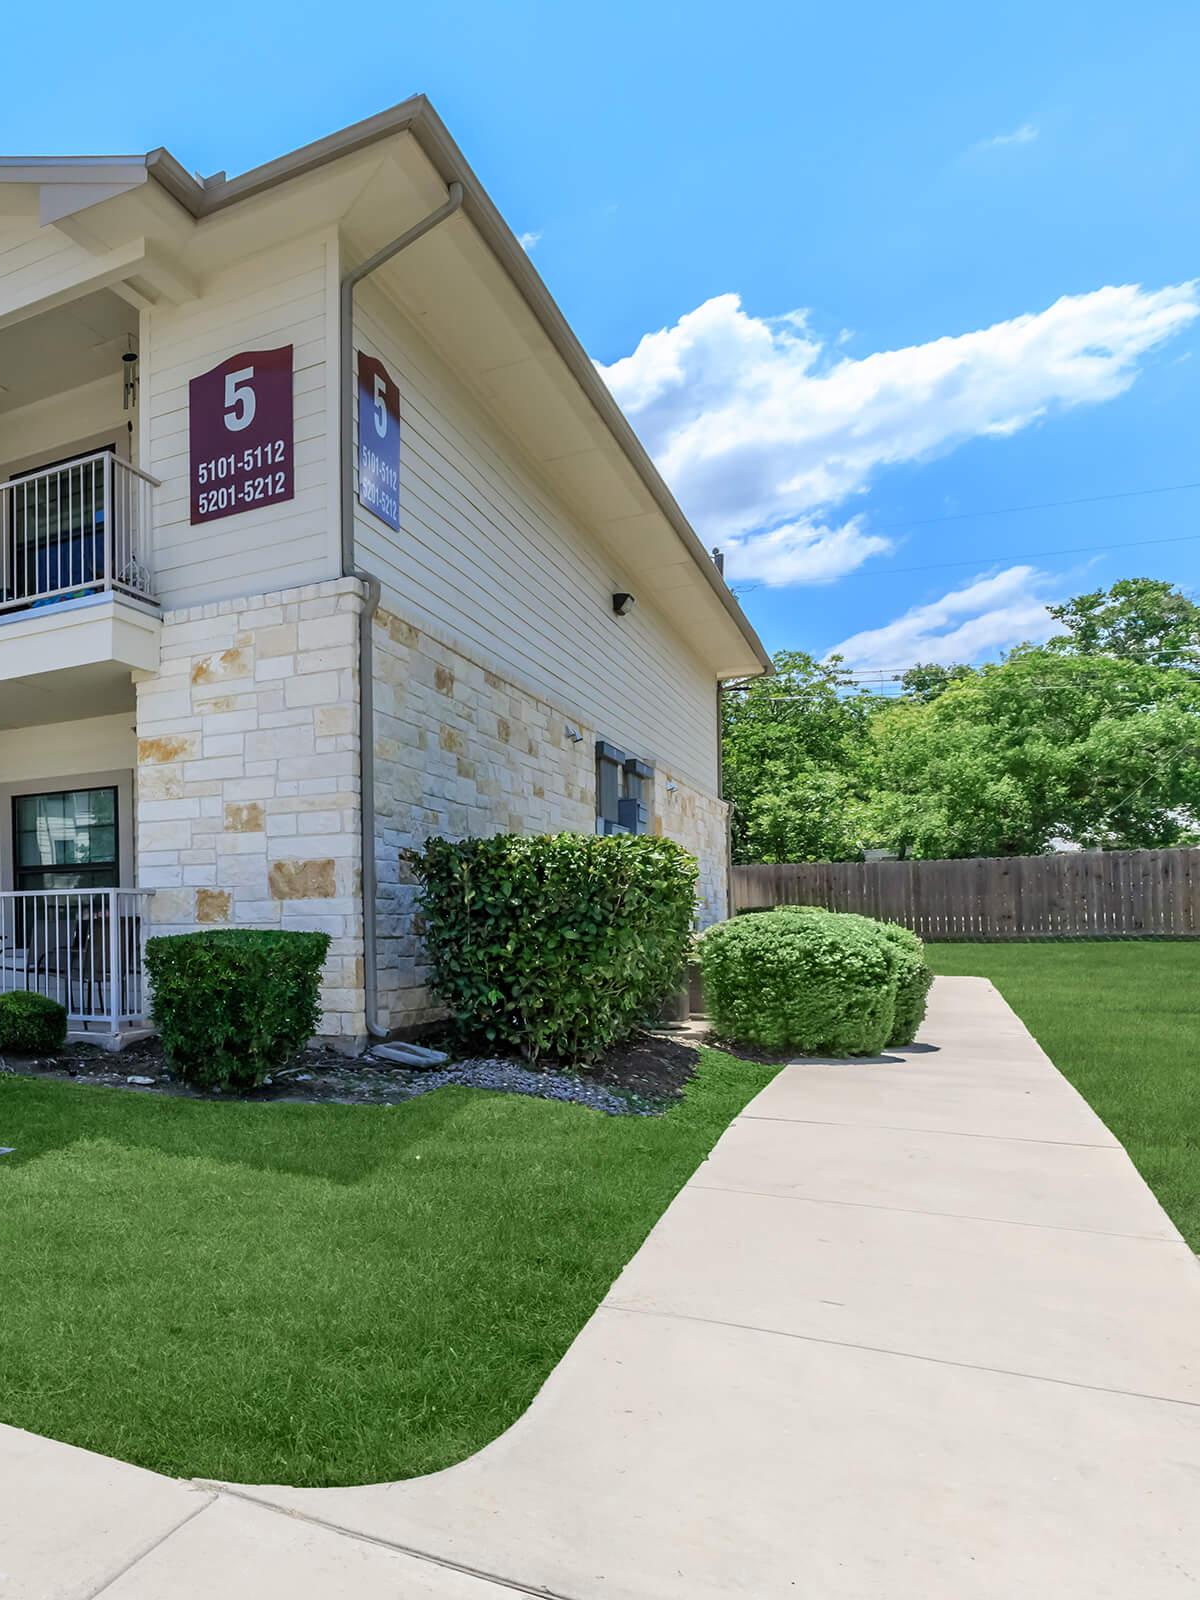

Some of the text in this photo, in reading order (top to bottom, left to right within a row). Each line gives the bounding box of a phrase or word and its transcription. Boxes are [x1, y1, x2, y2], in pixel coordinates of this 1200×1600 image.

[223, 366, 257, 432] 5
[374, 373, 388, 438] 5
[198, 440, 285, 484] 5101-5112
[362, 446, 398, 491] 5101-5112
[198, 471, 286, 514] 5201-5212
